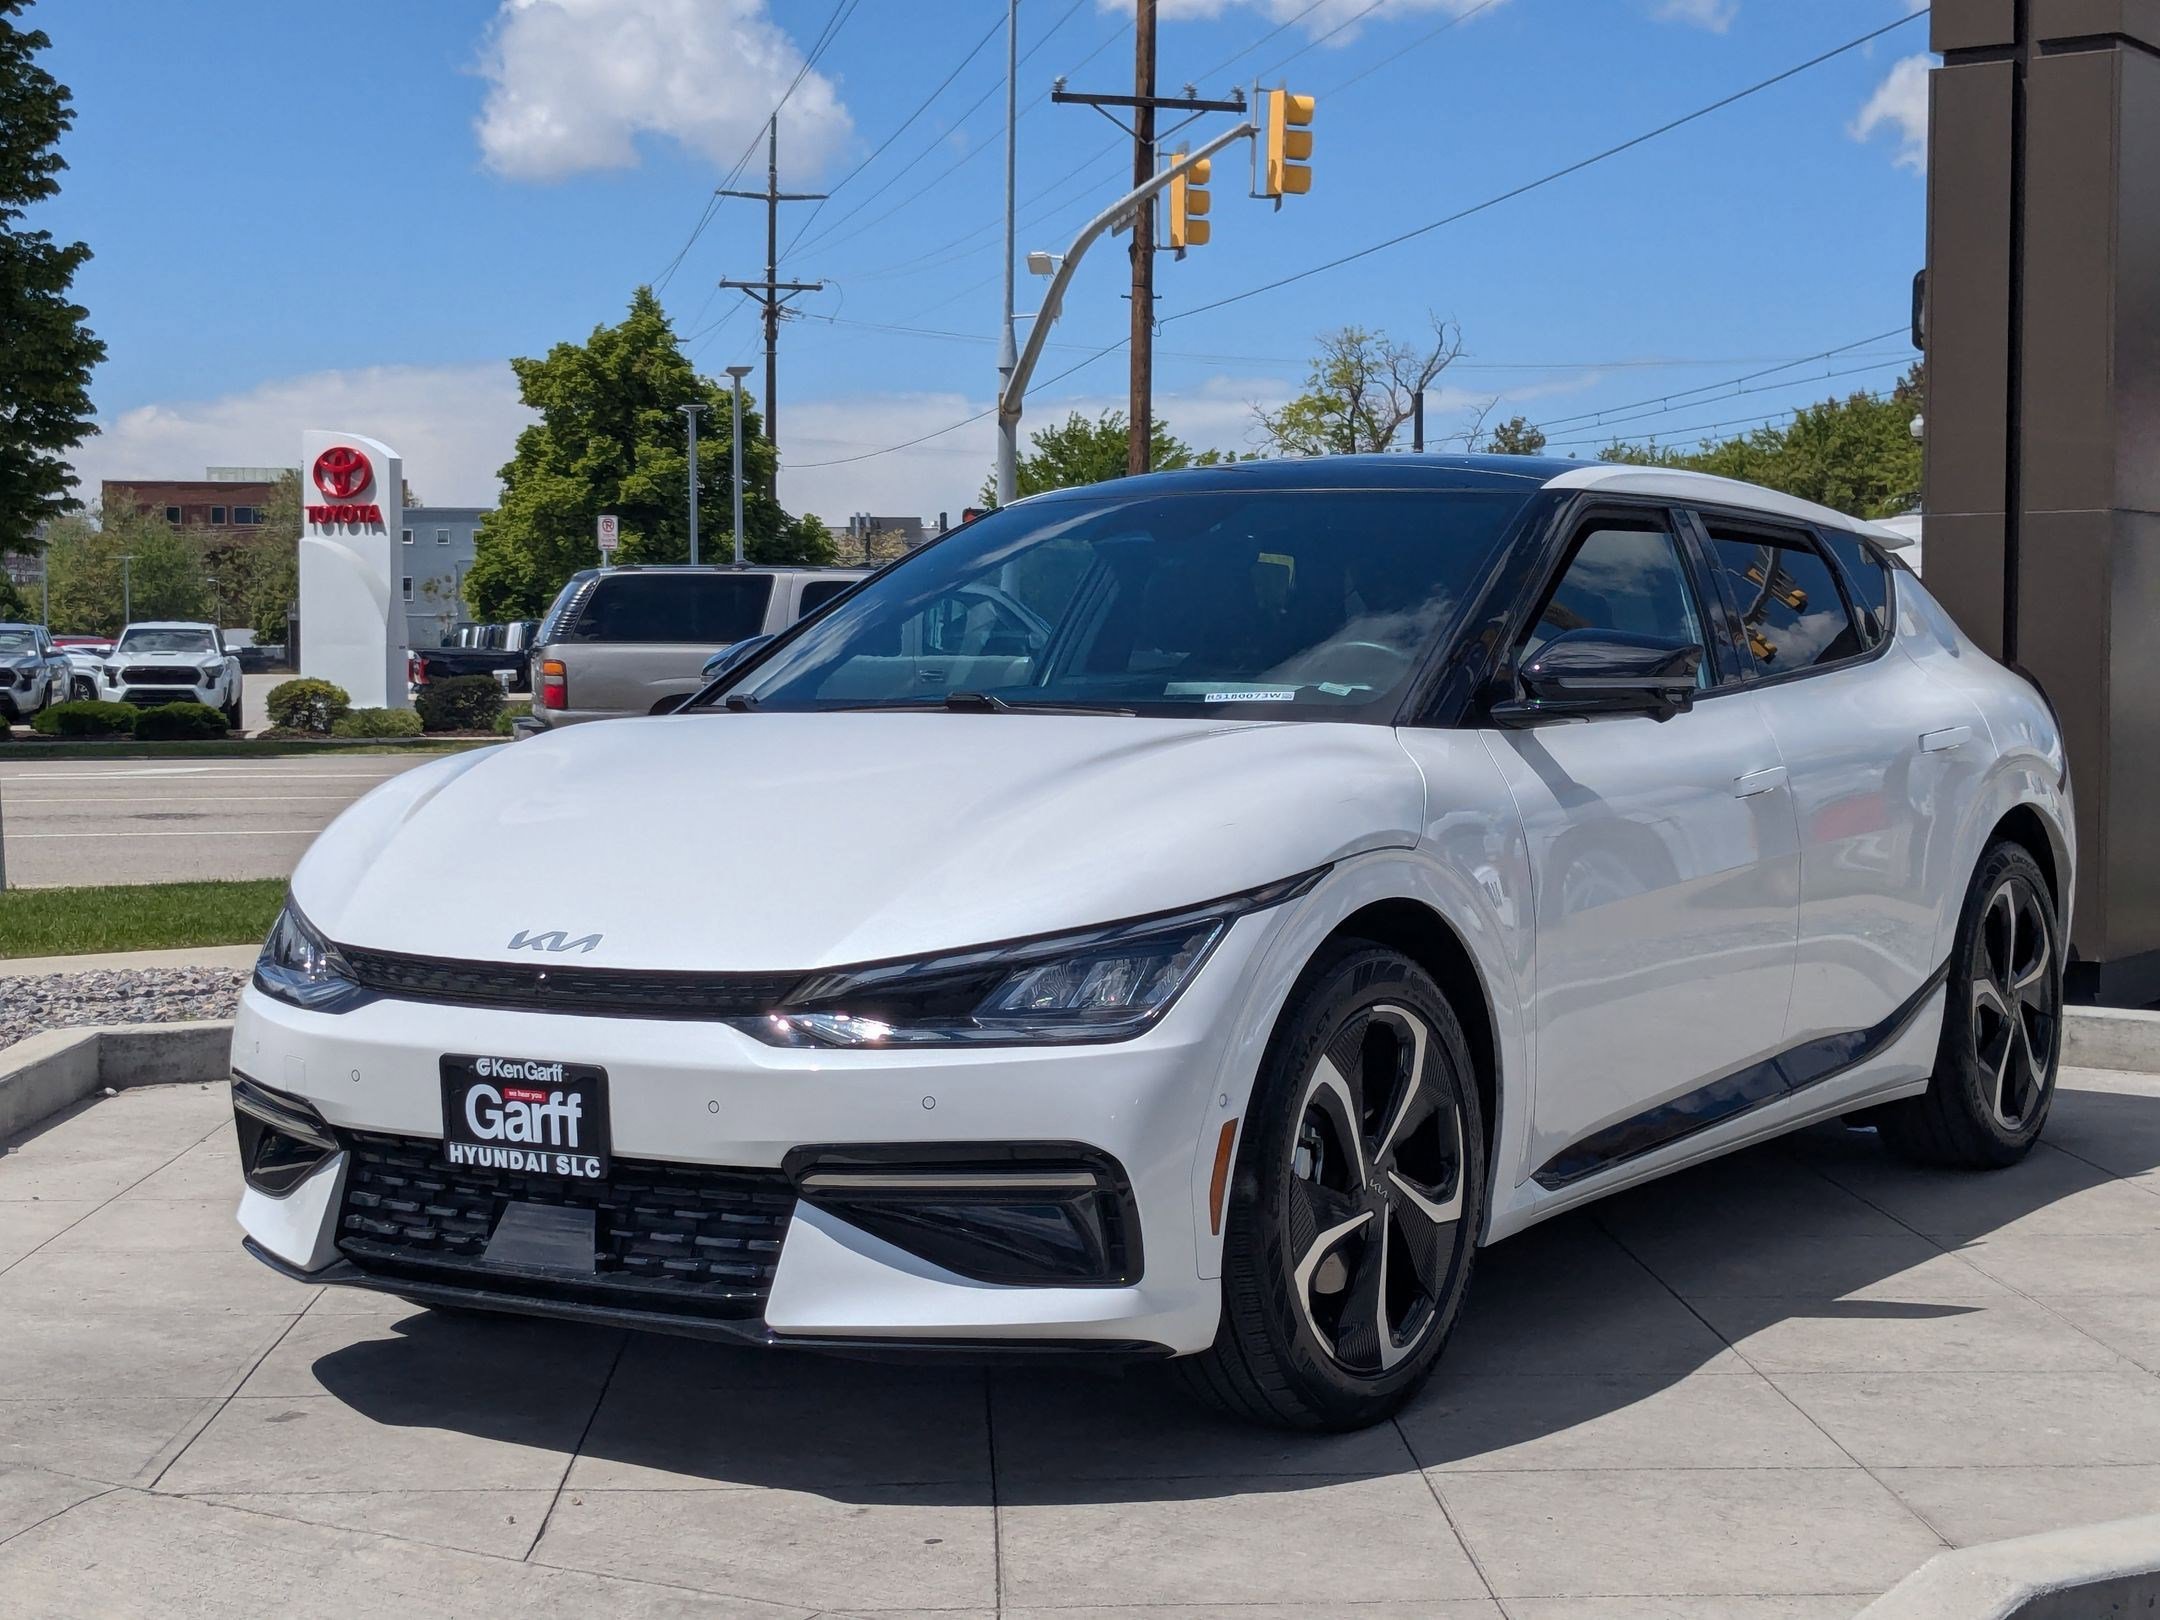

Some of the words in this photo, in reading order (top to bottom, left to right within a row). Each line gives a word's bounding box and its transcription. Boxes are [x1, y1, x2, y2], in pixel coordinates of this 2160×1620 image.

[305, 504, 383, 524] TOYOTA
[492, 1057, 524, 1079] Ken
[524, 1061, 563, 1082] Garff
[465, 1083, 582, 1148] Garff
[450, 1144, 549, 1173] HYUNDAI
[556, 1156, 600, 1178] SLC
